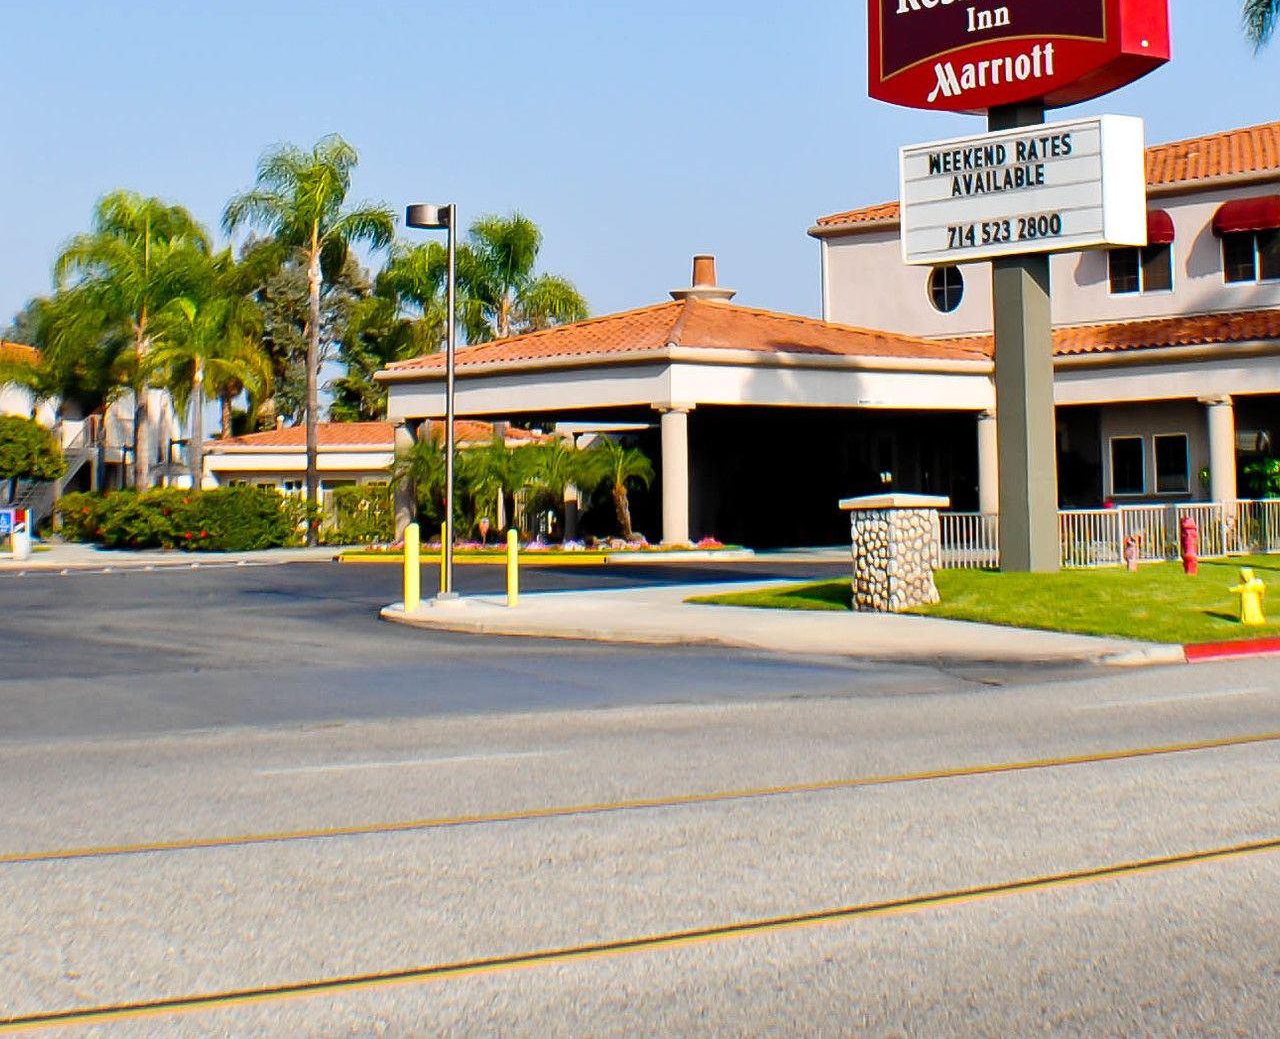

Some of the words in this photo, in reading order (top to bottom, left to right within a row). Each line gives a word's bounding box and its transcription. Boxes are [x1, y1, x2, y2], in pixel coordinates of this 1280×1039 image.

[966, 6, 1010, 32] Inn
[926, 42, 1054, 102] Marriott
[928, 144, 1006, 174] WEEKEND
[1015, 133, 1072, 160] RATES
[951, 164, 1045, 197] AVAILABLE
[947, 224, 976, 249] 714
[981, 220, 1011, 241] 523
[1017, 213, 1062, 238] 2800
